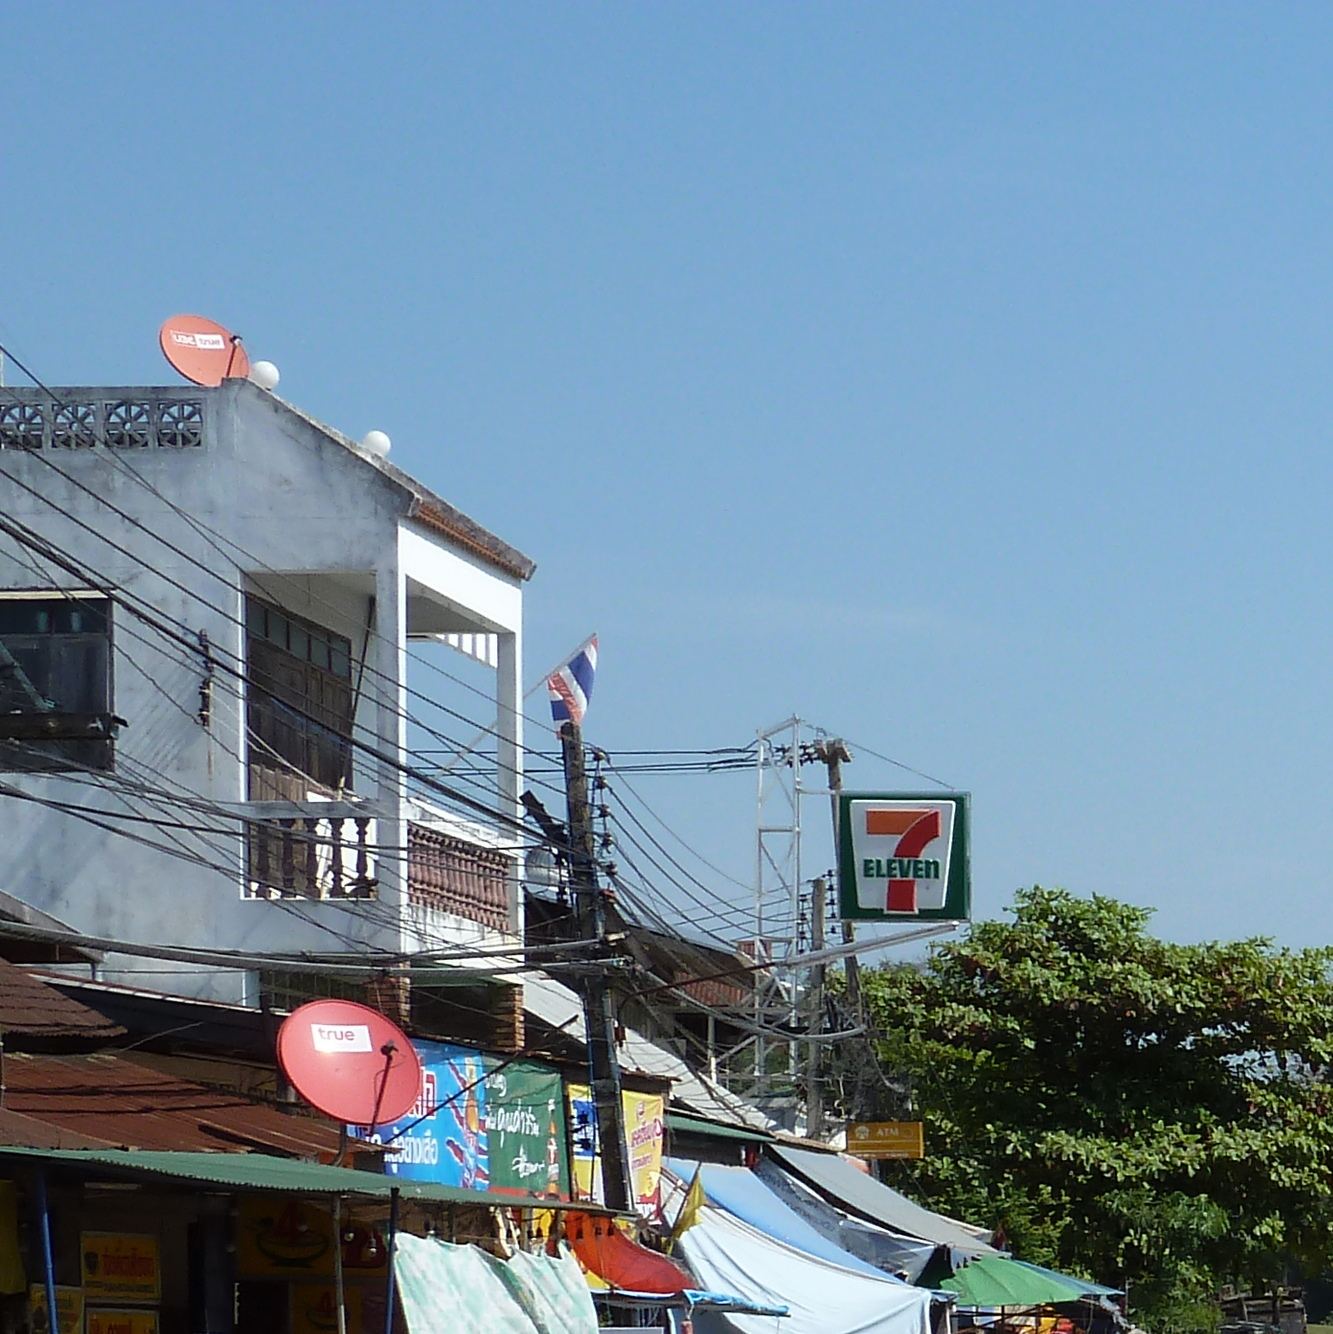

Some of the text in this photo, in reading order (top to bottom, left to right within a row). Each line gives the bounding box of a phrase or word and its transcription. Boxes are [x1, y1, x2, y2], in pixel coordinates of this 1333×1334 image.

[863, 859, 940, 879] ELEVEN
[866, 808, 940, 913] 7
[317, 1027, 355, 1041] true
